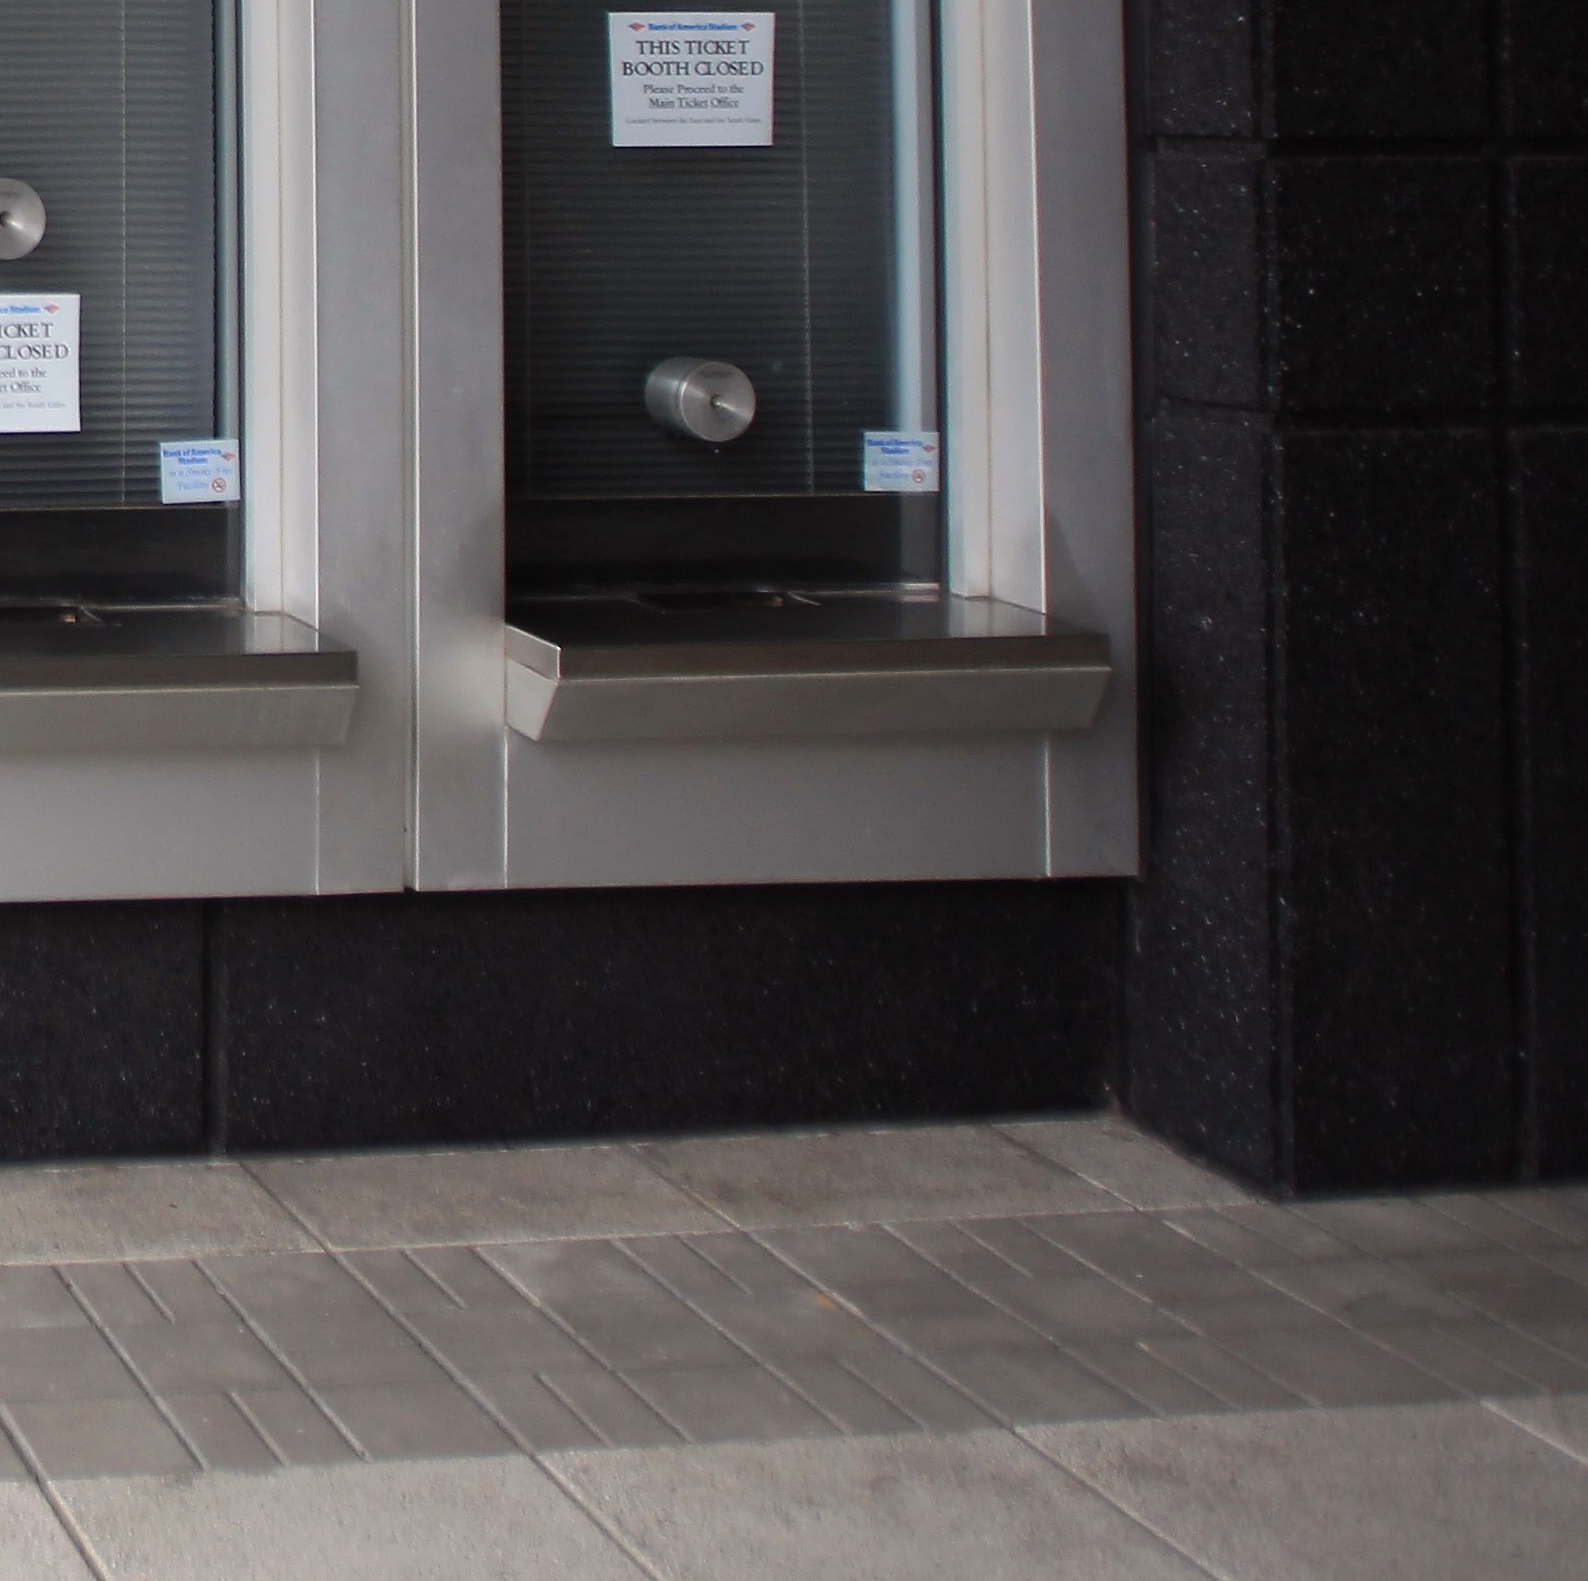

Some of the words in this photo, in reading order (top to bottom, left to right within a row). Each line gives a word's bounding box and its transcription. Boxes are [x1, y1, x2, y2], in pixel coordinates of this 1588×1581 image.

[637, 41, 679, 54] THIS
[684, 41, 748, 54] TICKET
[623, 61, 687, 76] BOOTH
[694, 61, 764, 76] CLOSED
[19, 370, 28, 378] to
[31, 368, 47, 378] the
[11, 382, 41, 392] Office
[191, 448, 221, 456] America
